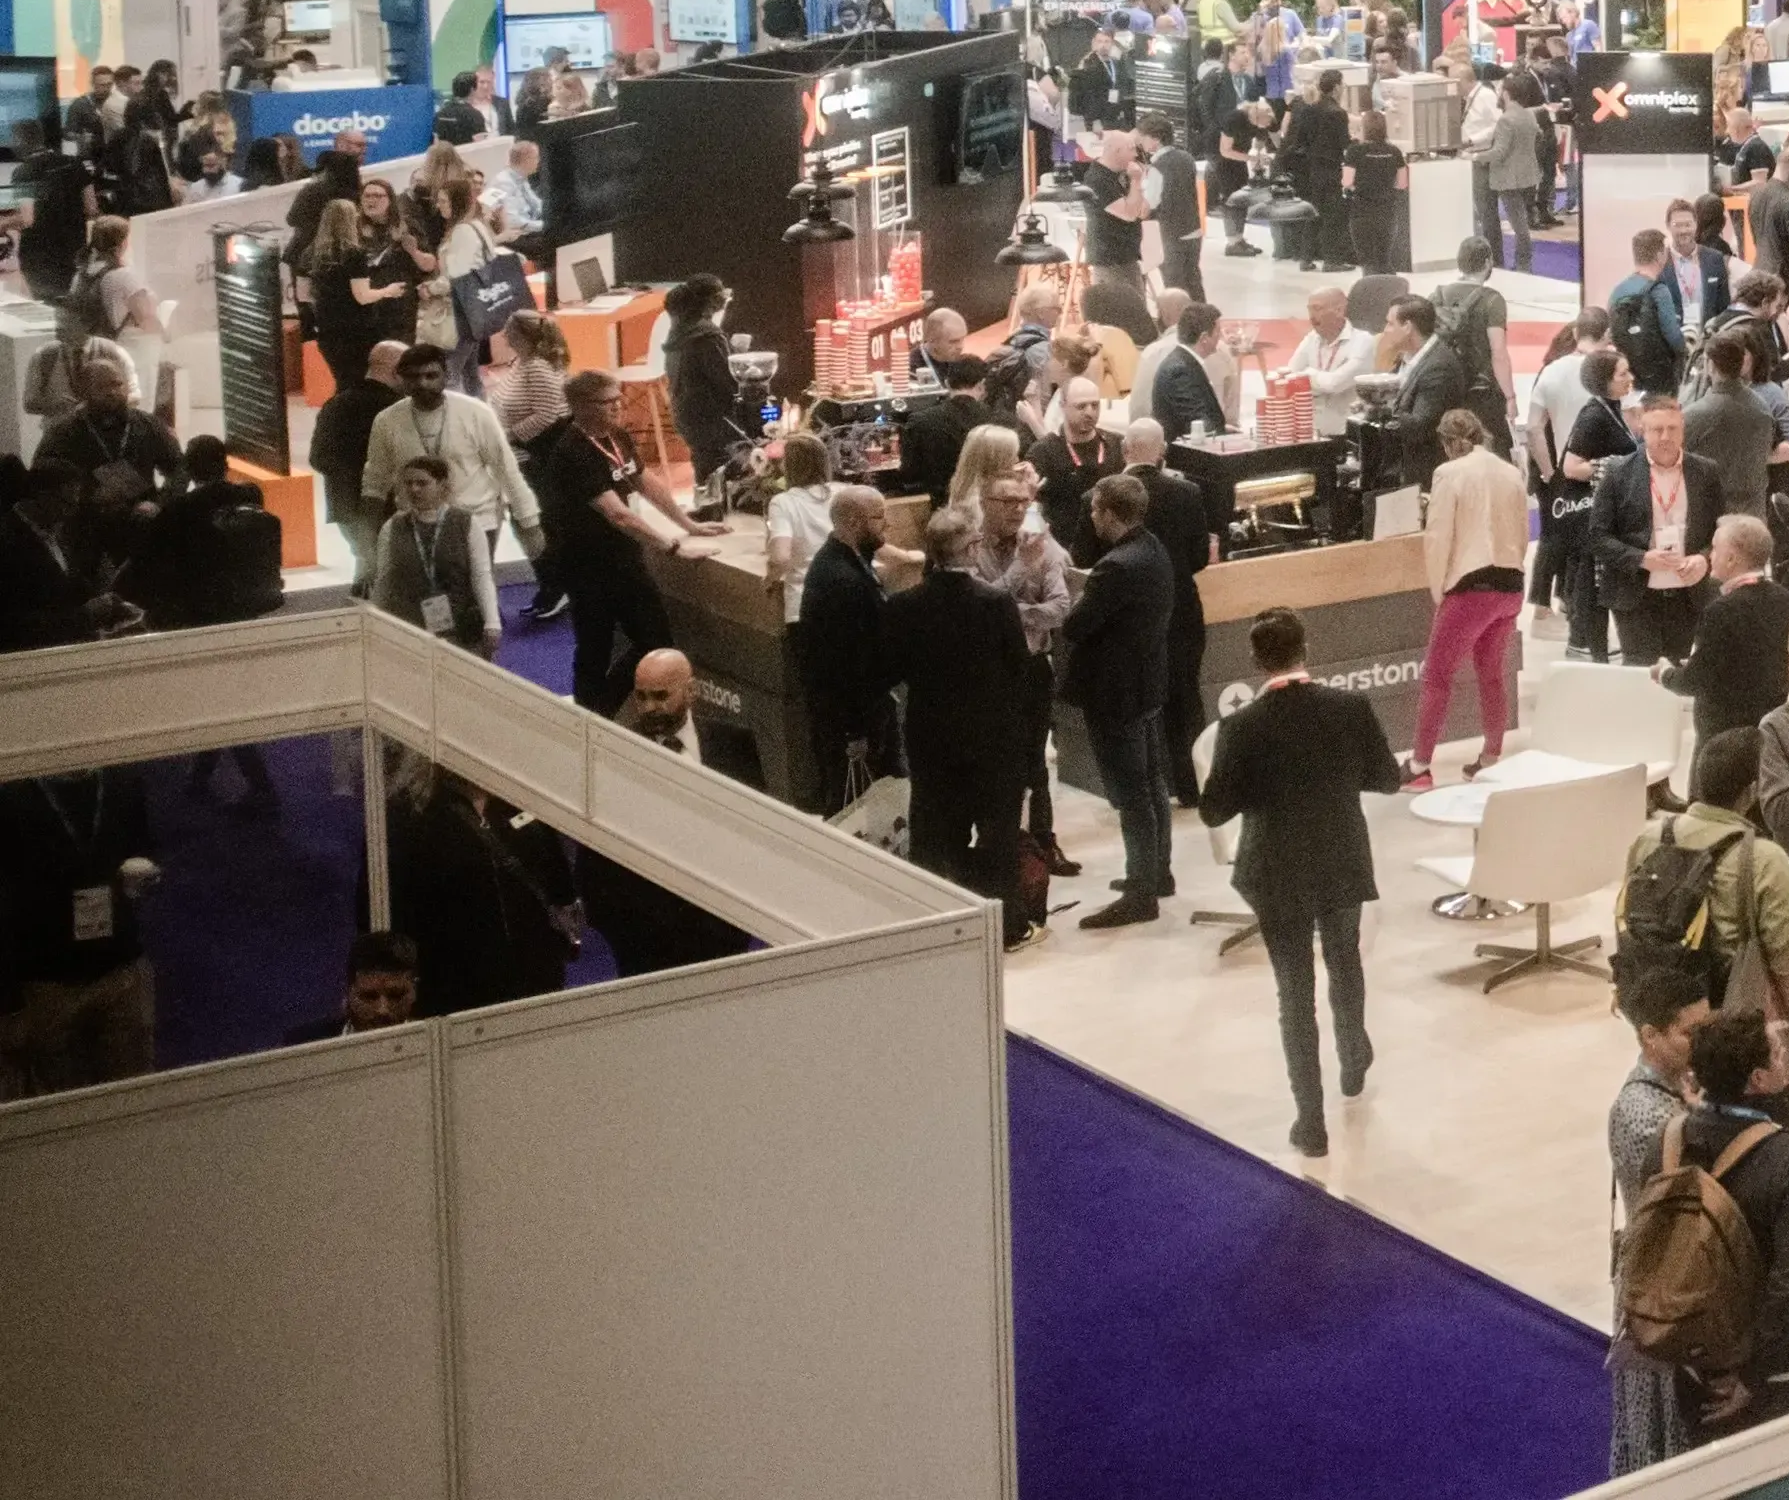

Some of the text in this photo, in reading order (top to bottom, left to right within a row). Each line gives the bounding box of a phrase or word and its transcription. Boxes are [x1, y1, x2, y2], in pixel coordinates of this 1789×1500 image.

[1623, 89, 1699, 109] omniplex
[293, 109, 386, 136] docebo
[871, 333, 885, 361] 01
